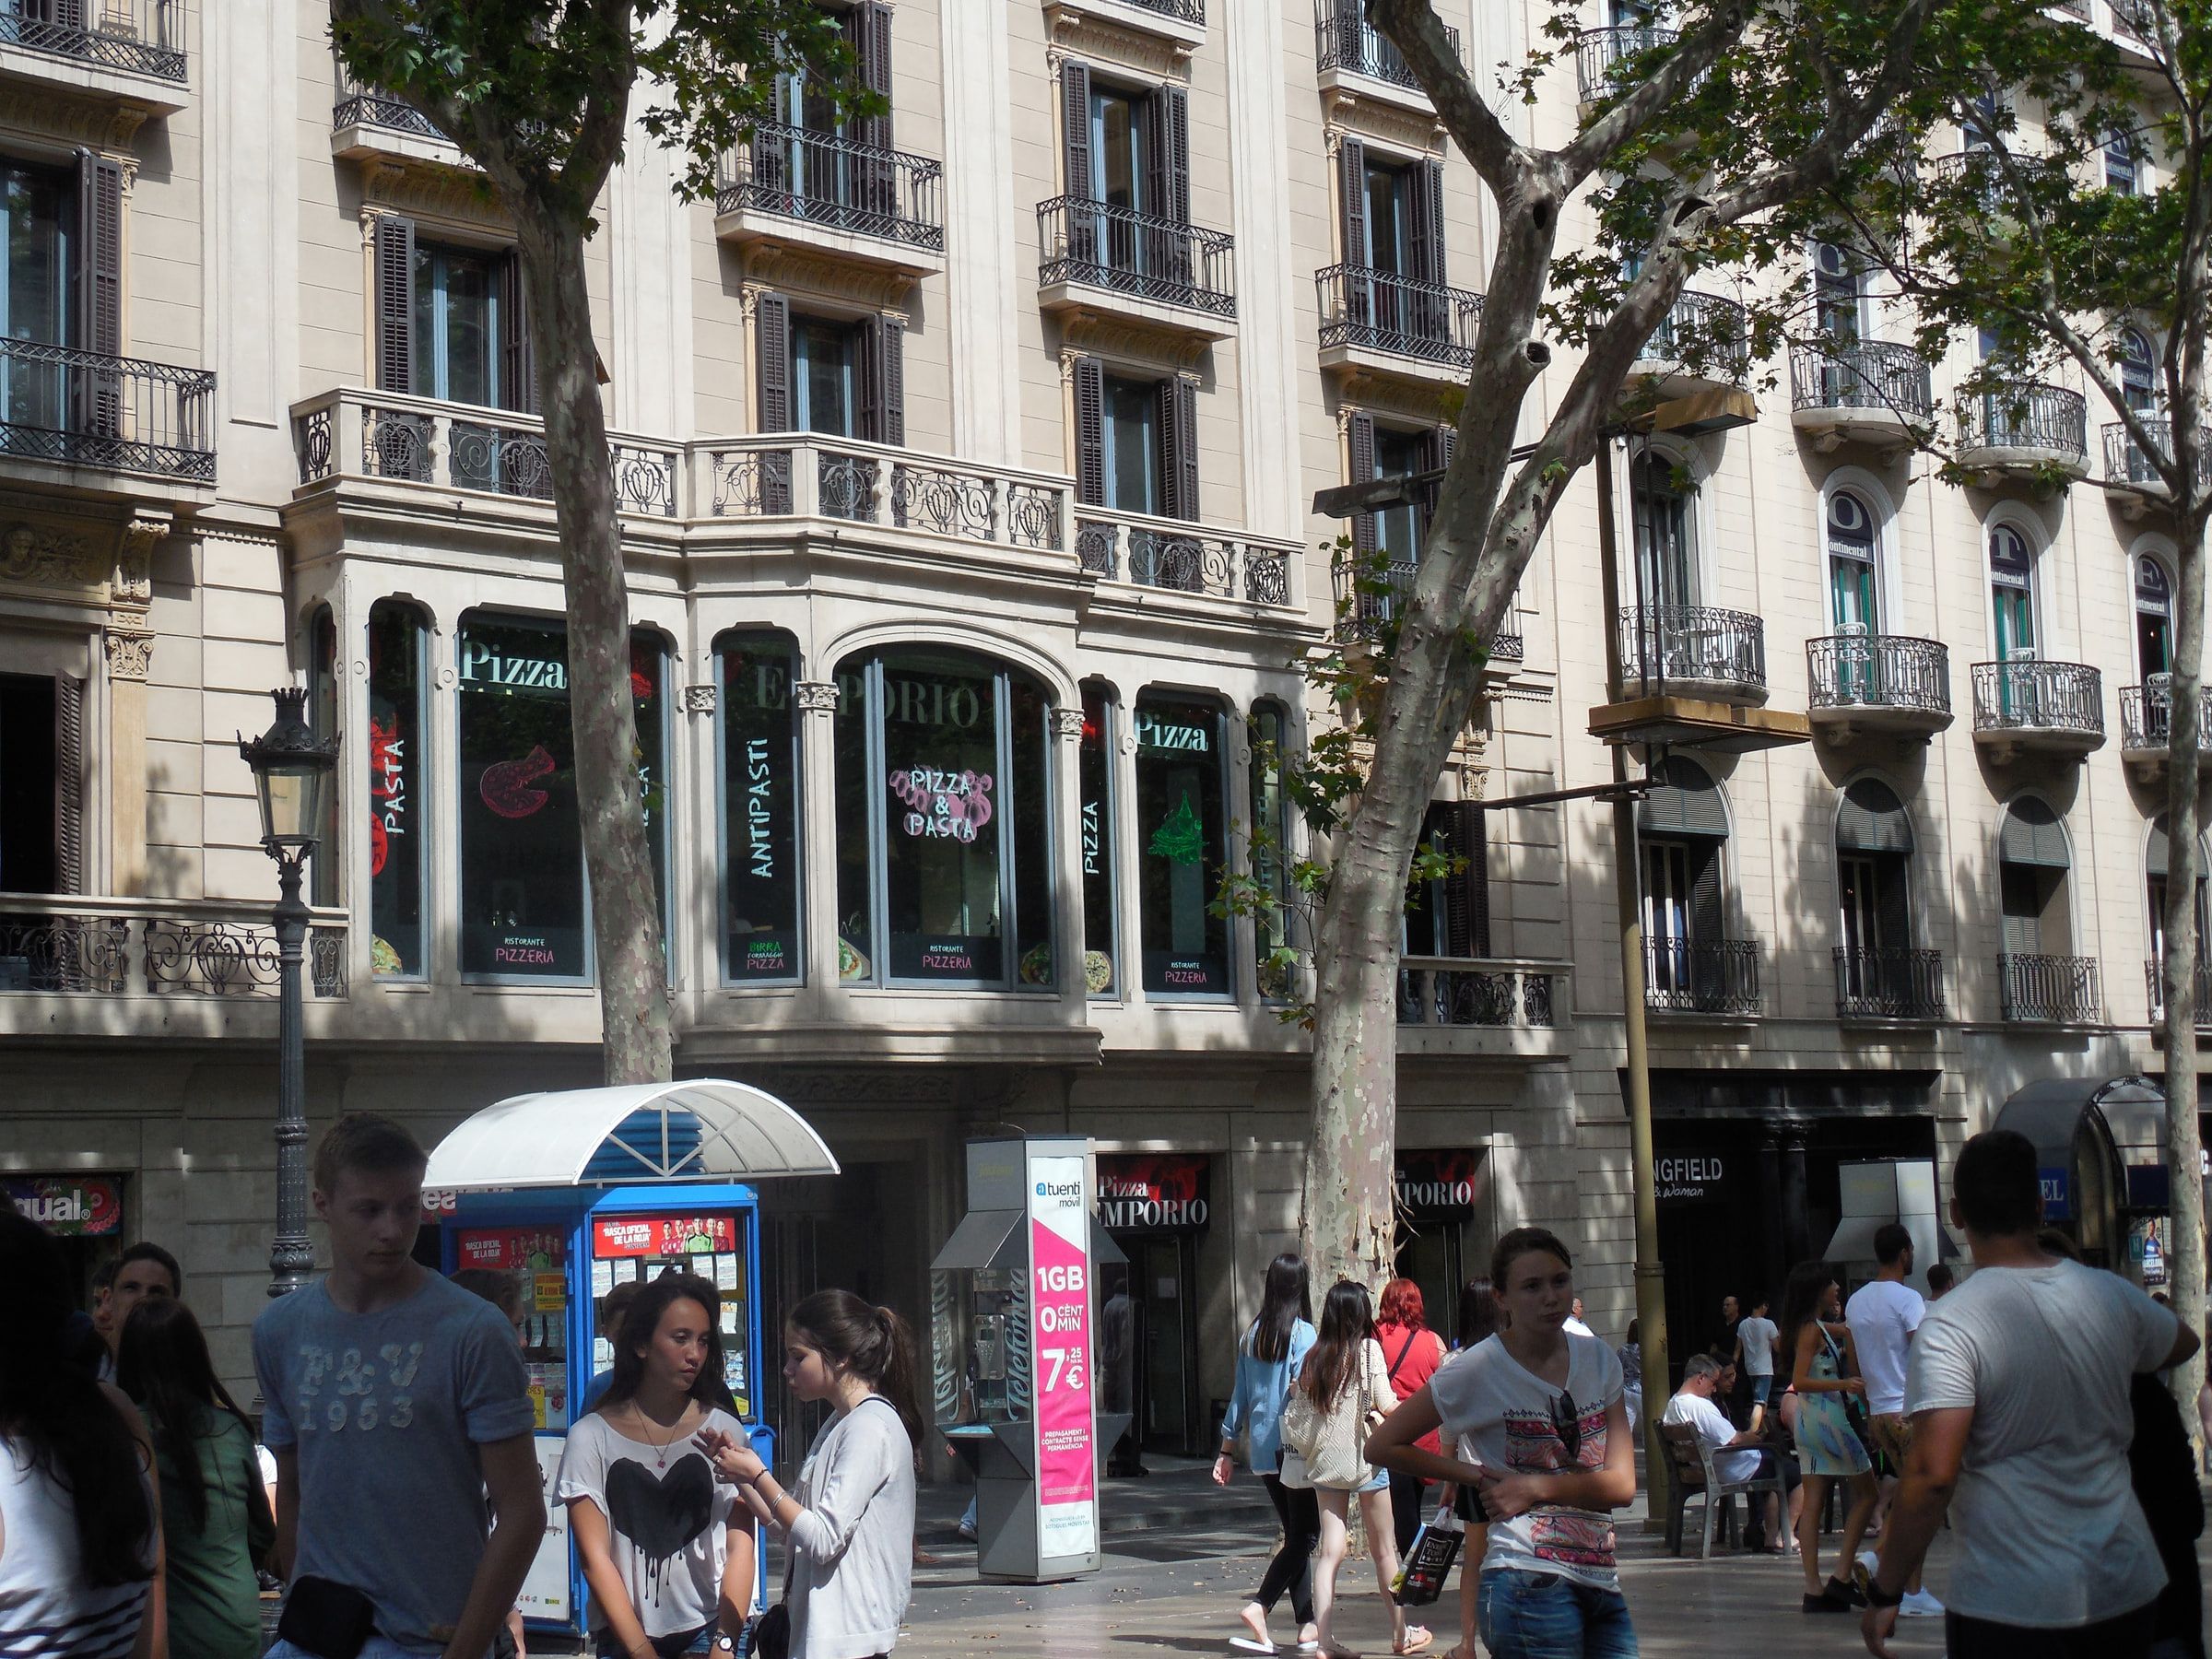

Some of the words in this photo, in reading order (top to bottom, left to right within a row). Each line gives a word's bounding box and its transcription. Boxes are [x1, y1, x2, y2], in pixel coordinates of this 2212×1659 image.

[1827, 495, 1863, 530] O
[1829, 540, 1867, 559] ontinental
[461, 641, 567, 690] Pizza
[1135, 712, 1208, 752] Pizza
[384, 739, 406, 835] PASTA
[911, 771, 971, 796] PIZZA
[935, 796, 950, 816] &
[910, 816, 976, 841] PASTA
[504, 937, 545, 947] RISTORANTE
[929, 945, 964, 954] RISTORANTE
[1171, 961, 1200, 970] RISTORANTE
[1653, 1158, 1723, 1182] NGFIELD
[1047, 1182, 1080, 1196] tuenti
[1097, 1175, 1149, 1198] Pizza
[1663, 1182, 1704, 1198] Woman
[1059, 1196, 1080, 1207] móvil
[614, 1236, 623, 1245] DE
[624, 1235, 633, 1244] LA
[627, 1224, 651, 1235] OFICIAL
[1037, 1265, 1084, 1292] 1GB
[1041, 1306, 1057, 1333] 0
[1057, 1317, 1081, 1332] MIN
[1065, 1365, 1084, 1390] €
